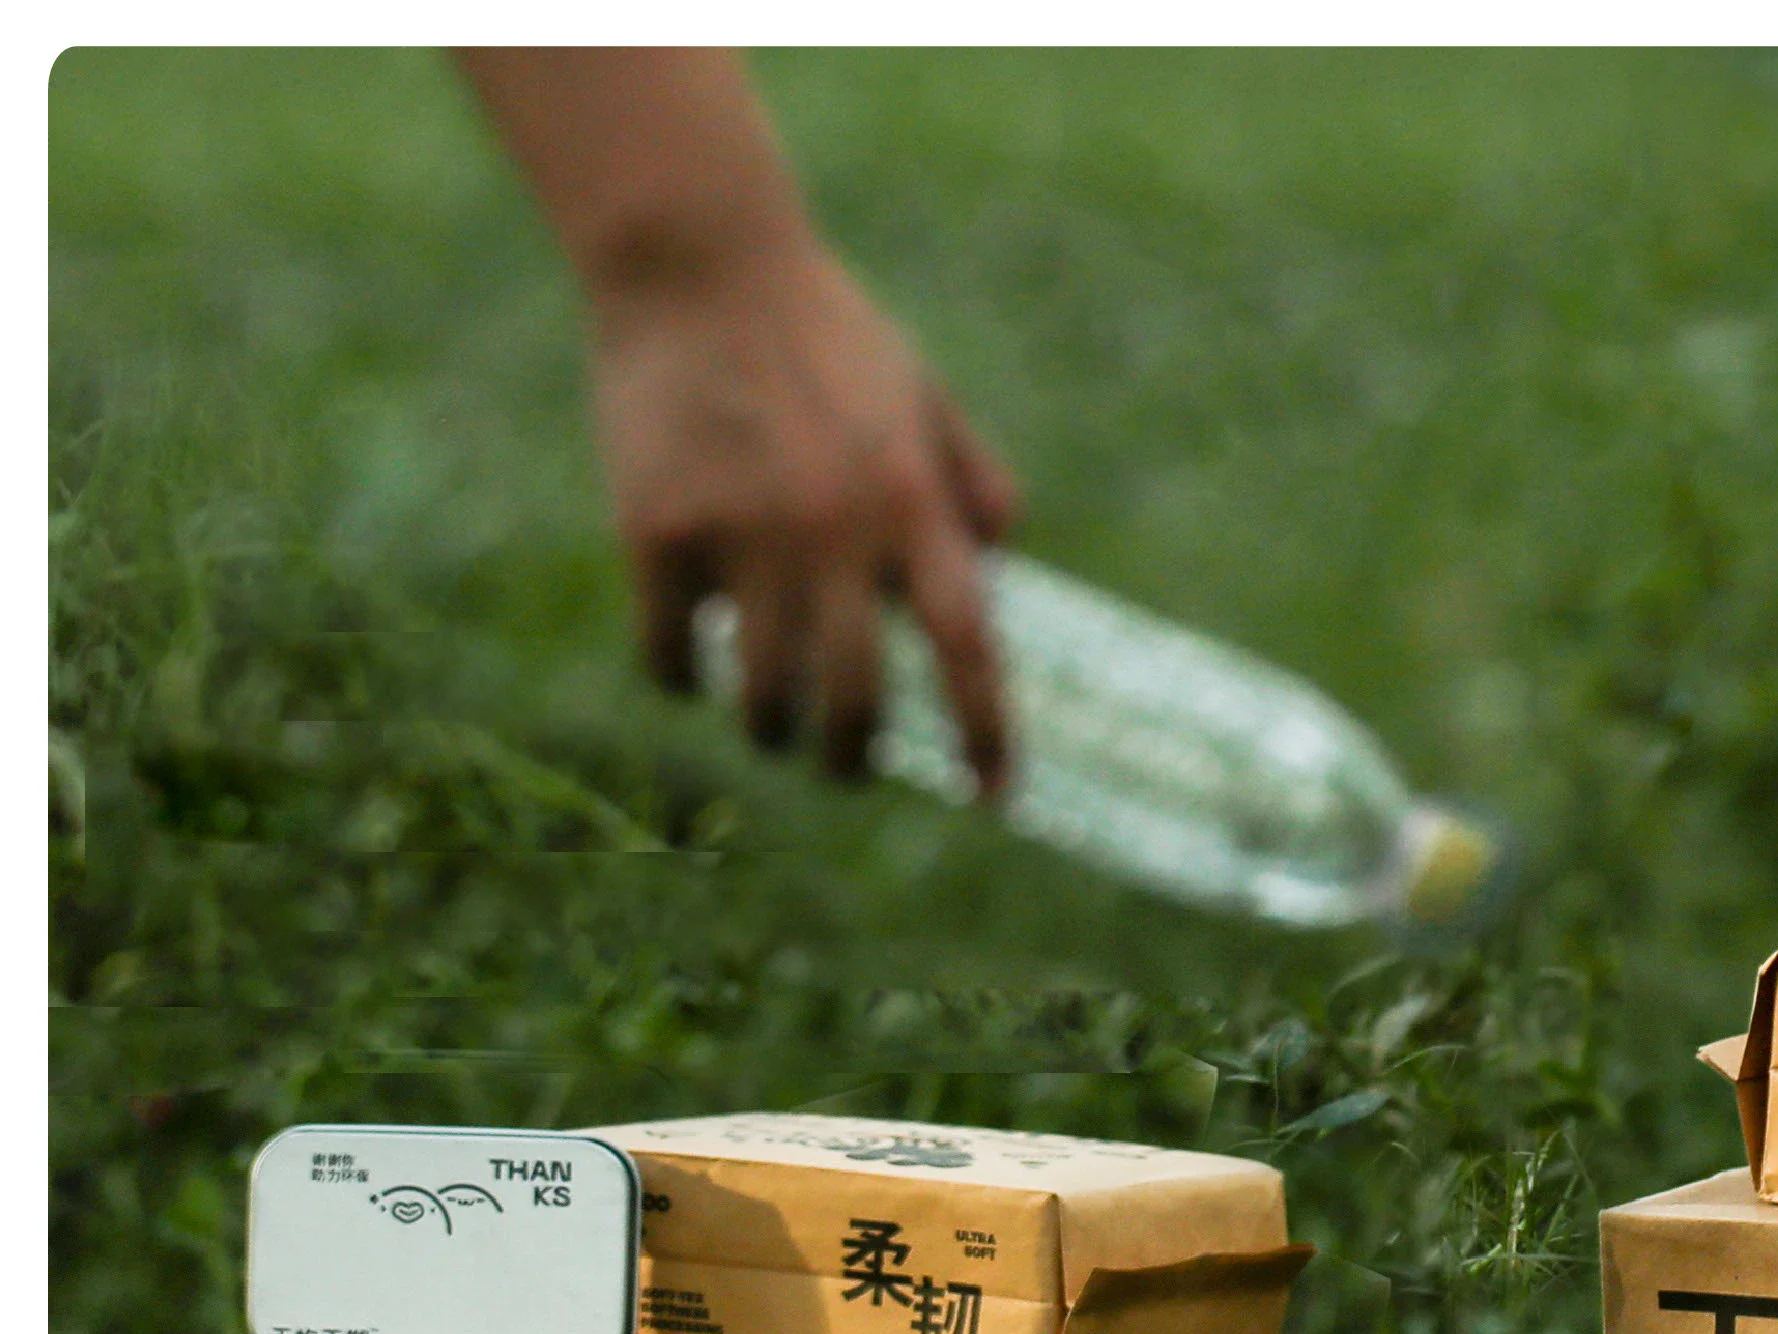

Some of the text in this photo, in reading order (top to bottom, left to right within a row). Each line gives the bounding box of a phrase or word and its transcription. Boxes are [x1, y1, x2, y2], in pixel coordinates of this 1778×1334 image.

[489, 1158, 572, 1182] THAN
[533, 1185, 571, 1207] KS
[955, 1229, 997, 1245] ULTRA
[964, 1245, 997, 1261] SOFT
